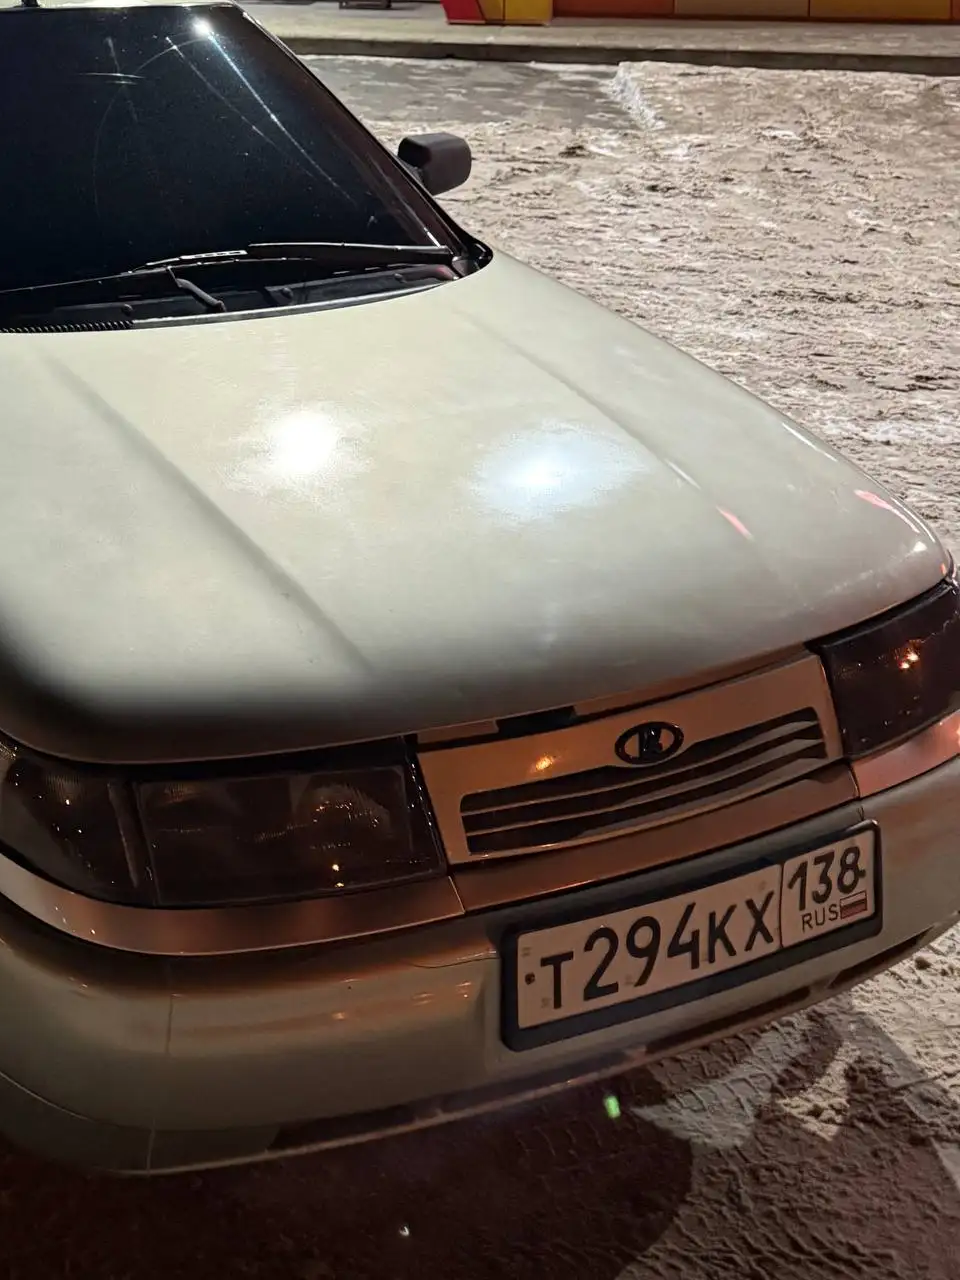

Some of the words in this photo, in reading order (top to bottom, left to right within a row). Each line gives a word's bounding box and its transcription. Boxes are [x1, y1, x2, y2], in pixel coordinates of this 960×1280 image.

[540, 890, 774, 1010] Т294КХ
[788, 846, 867, 911] 138
[800, 904, 839, 932] RUS
